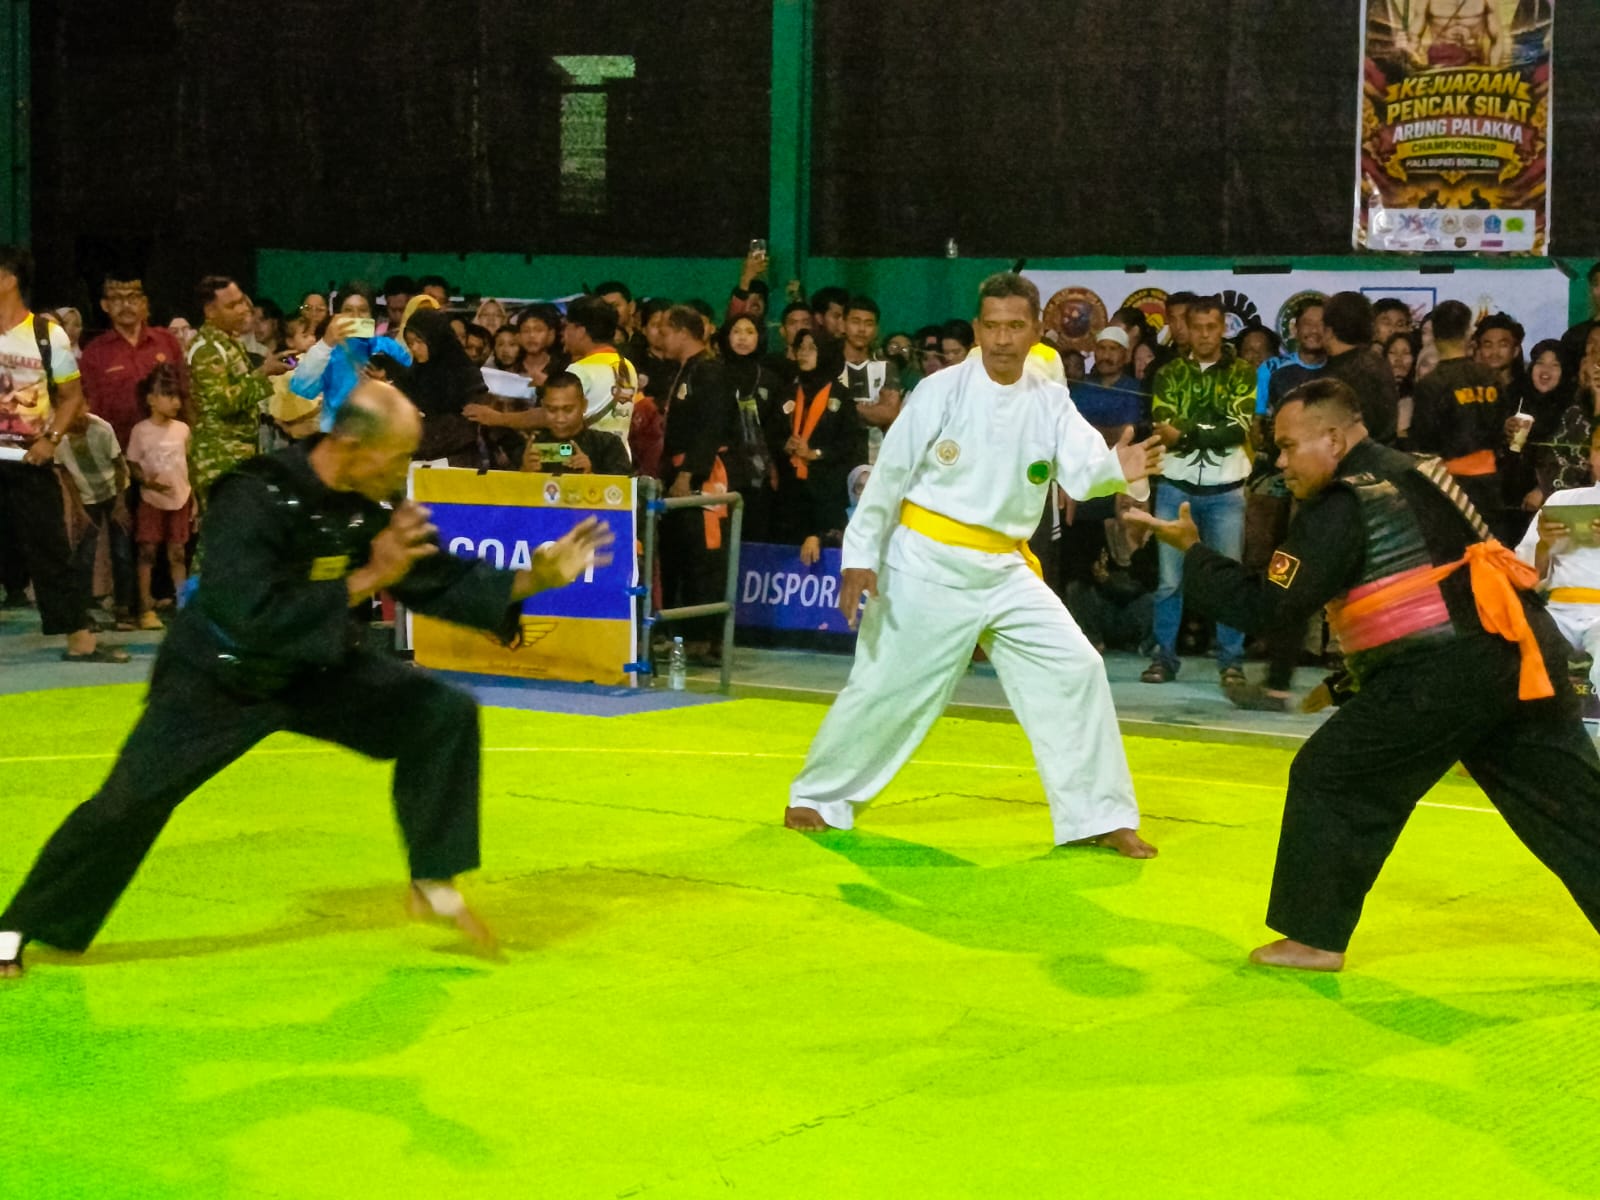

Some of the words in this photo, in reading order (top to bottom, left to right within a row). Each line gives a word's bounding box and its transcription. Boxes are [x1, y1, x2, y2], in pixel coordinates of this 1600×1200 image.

[1400, 71, 1521, 97] KEJUARAAN
[1386, 94, 1470, 126] PENCAK
[1474, 94, 1531, 124] SILAT
[1391, 119, 1448, 144] ARUNG
[1451, 118, 1524, 145] PALAKKA
[1411, 140, 1497, 153] CHAMPIONSHIP
[743, 570, 842, 609] DISPOR
